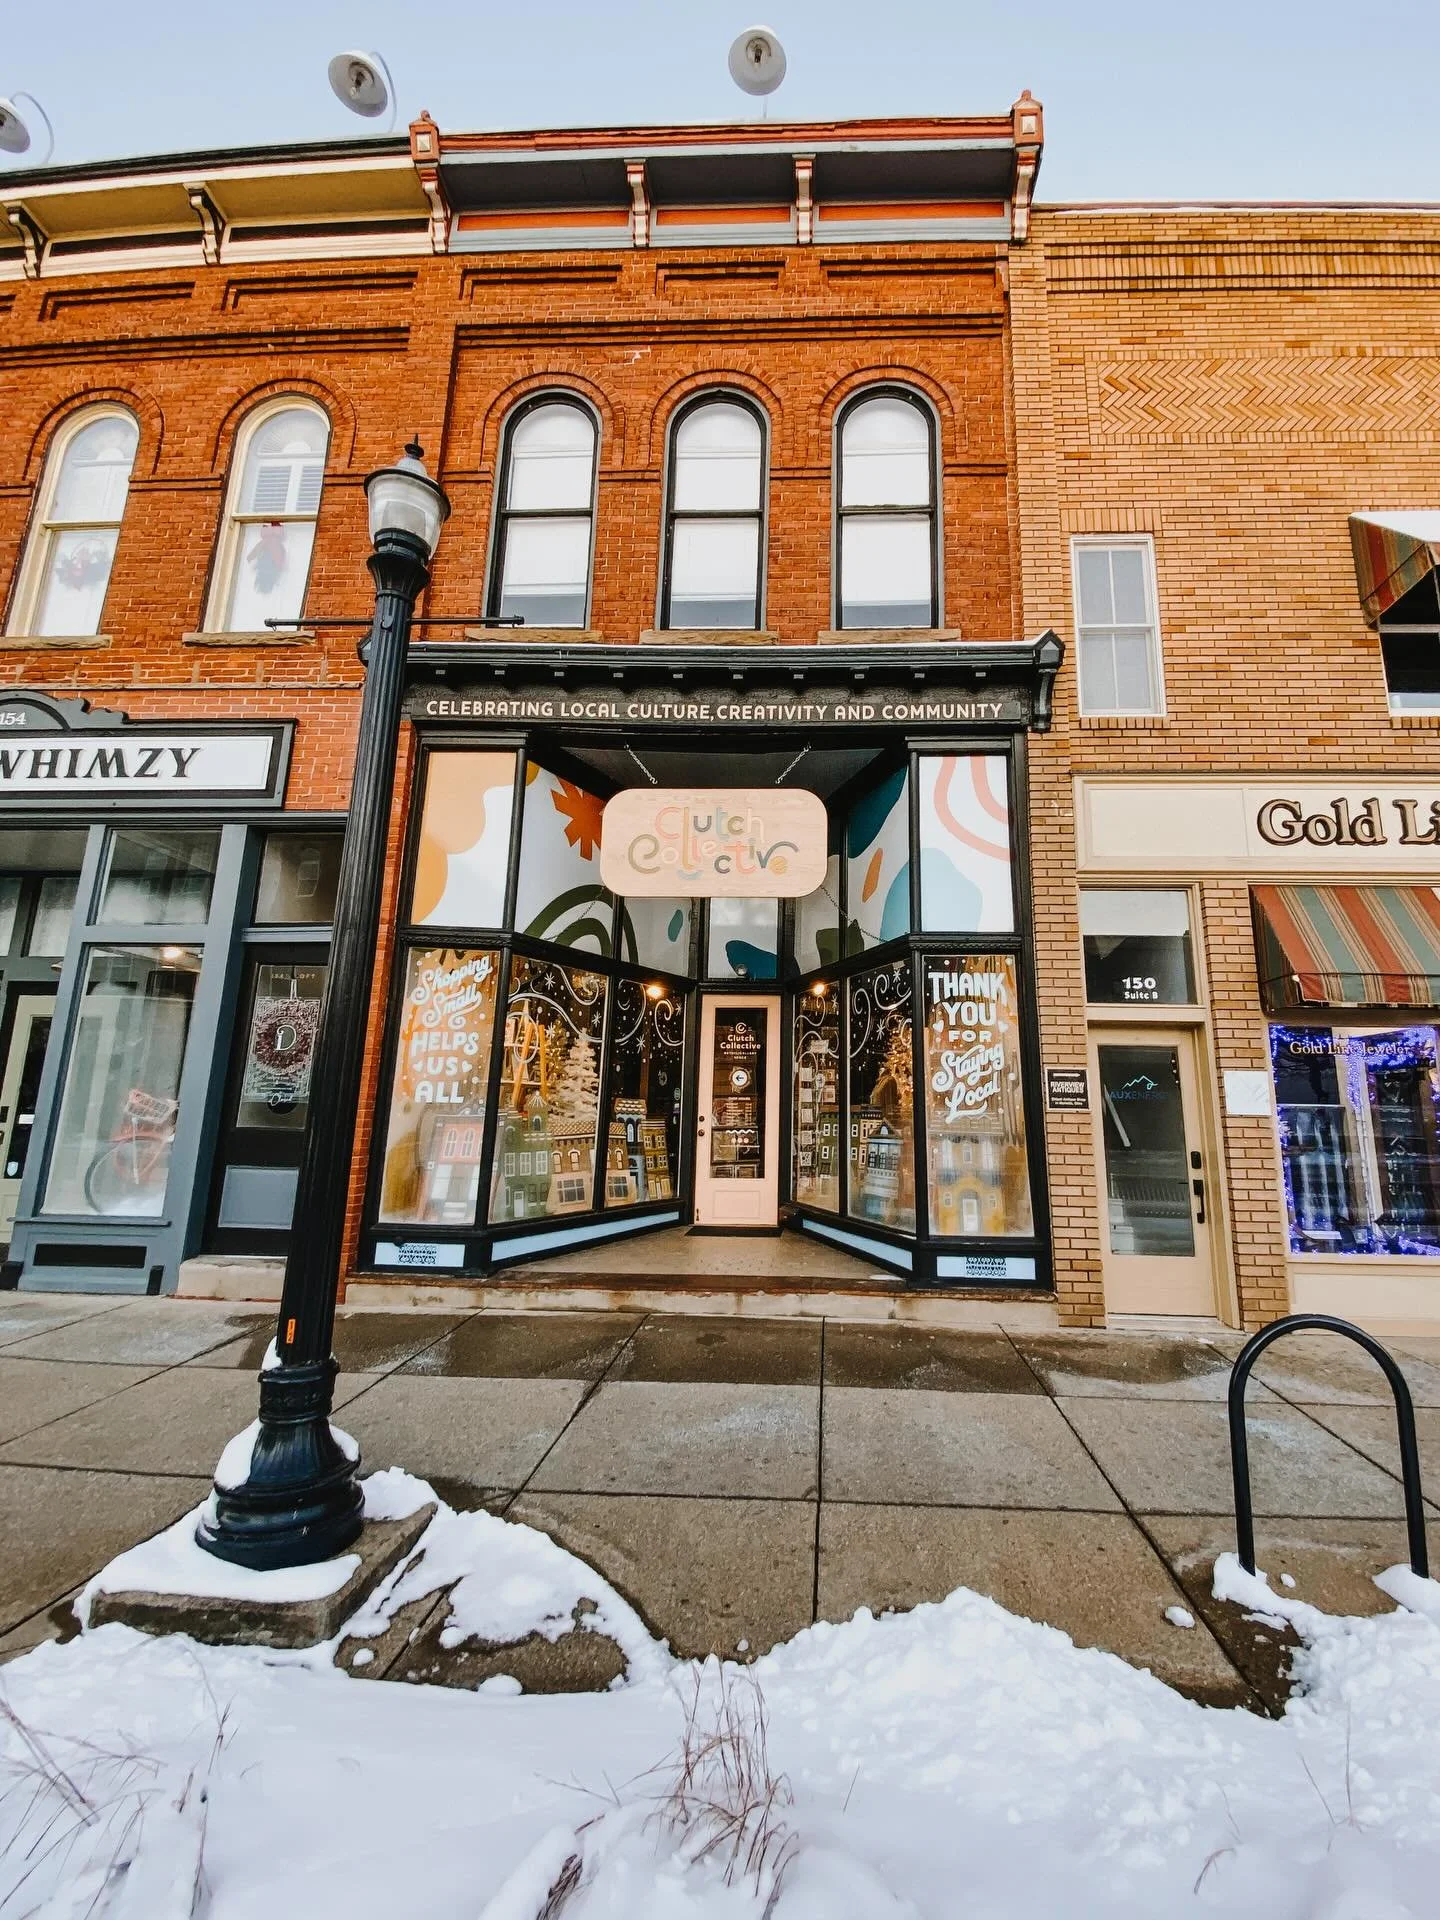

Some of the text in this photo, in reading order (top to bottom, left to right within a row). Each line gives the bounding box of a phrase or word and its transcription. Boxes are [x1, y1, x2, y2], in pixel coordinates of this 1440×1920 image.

[0, 712, 26, 726] 154
[426, 700, 553, 716] CELEBRATING
[561, 702, 620, 718] LOCAL
[716, 704, 828, 720] CREATIVITY
[834, 704, 875, 720] AND
[882, 703, 1003, 719] COMMUNITY
[655, 806, 766, 843] Clutch
[1257, 797, 1387, 846] Gold
[628, 833, 800, 878] Collective
[410, 955, 493, 1006] Shopping
[928, 972, 1008, 1007] THANK
[1122, 977, 1157, 989] 150
[422, 983, 483, 1030] Small
[1124, 991, 1150, 1000] Suite
[942, 1001, 996, 1026] YOU
[411, 1031, 480, 1056] HELPS
[720, 1042, 761, 1050] Collective
[728, 1034, 754, 1042] Clutch
[948, 1030, 993, 1043] FOR
[1289, 1041, 1324, 1055] Gold
[427, 1056, 459, 1077] US
[932, 1043, 1005, 1093] Staying
[414, 1080, 465, 1105] ALL
[945, 1071, 1001, 1124] Local
